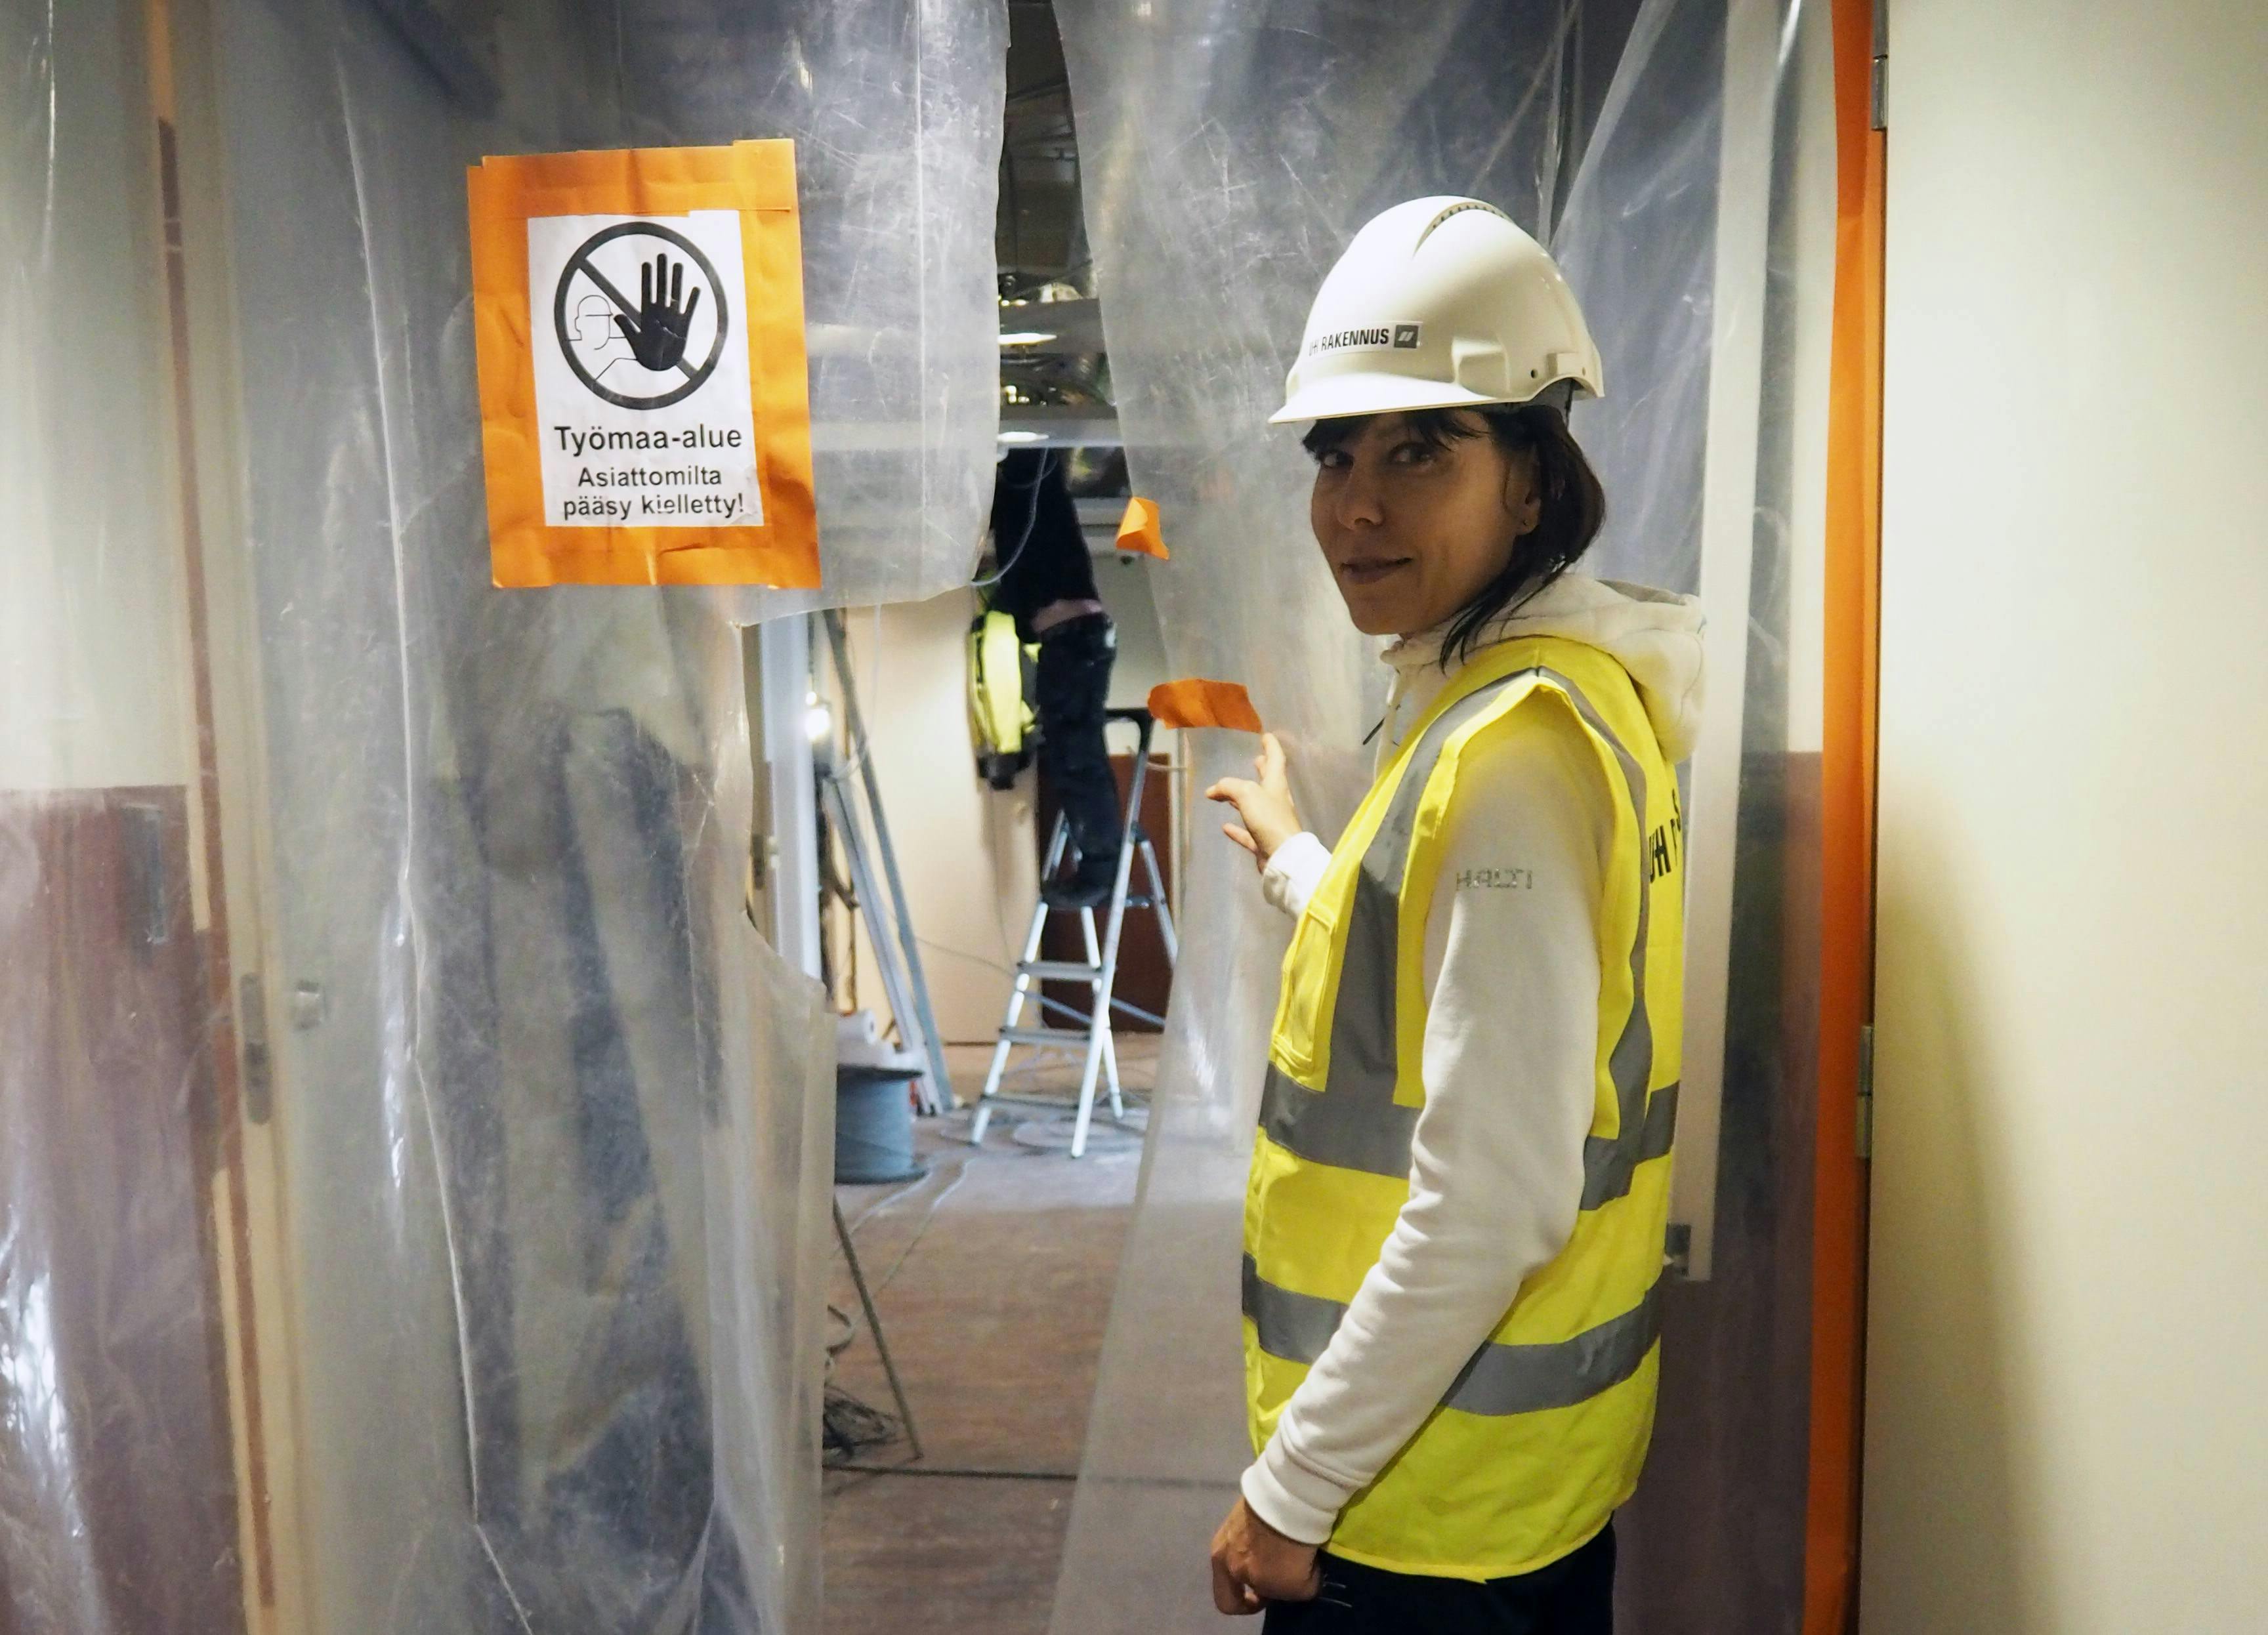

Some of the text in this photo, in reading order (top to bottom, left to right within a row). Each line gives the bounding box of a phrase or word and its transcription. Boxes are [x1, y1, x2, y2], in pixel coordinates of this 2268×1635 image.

[1321, 329, 1389, 351] RAKENNUS
[554, 423, 742, 456] Työmaa-alue
[578, 465, 722, 487] Asiattomilta
[564, 493, 744, 520] pääsy kielletty!
